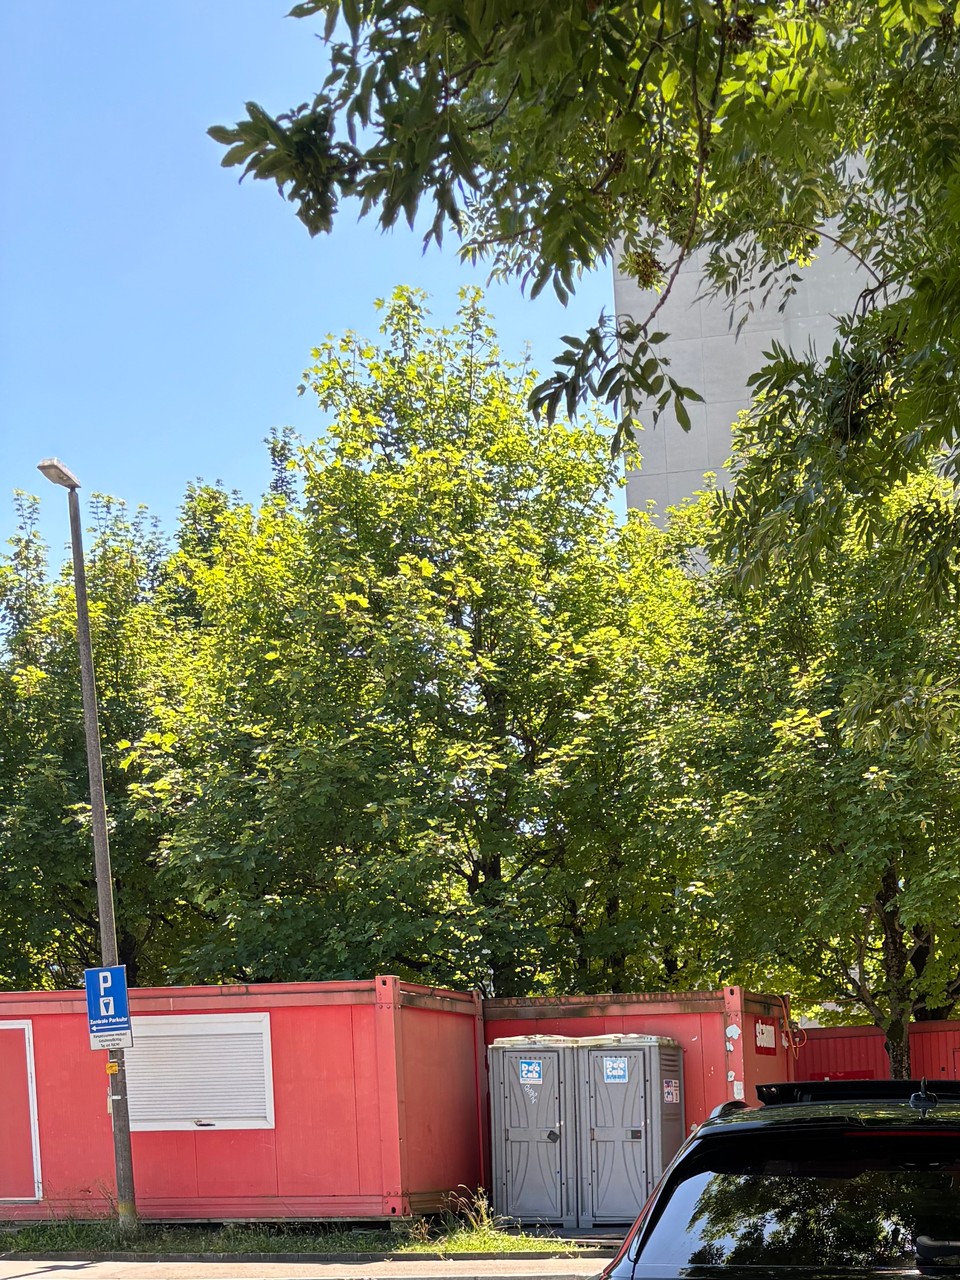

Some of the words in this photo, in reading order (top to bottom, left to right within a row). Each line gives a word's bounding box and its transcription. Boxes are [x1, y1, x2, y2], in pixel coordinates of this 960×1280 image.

[99, 971, 112, 996] P
[521, 1070, 539, 1078] Cab
[606, 1067, 624, 1075] Cab
